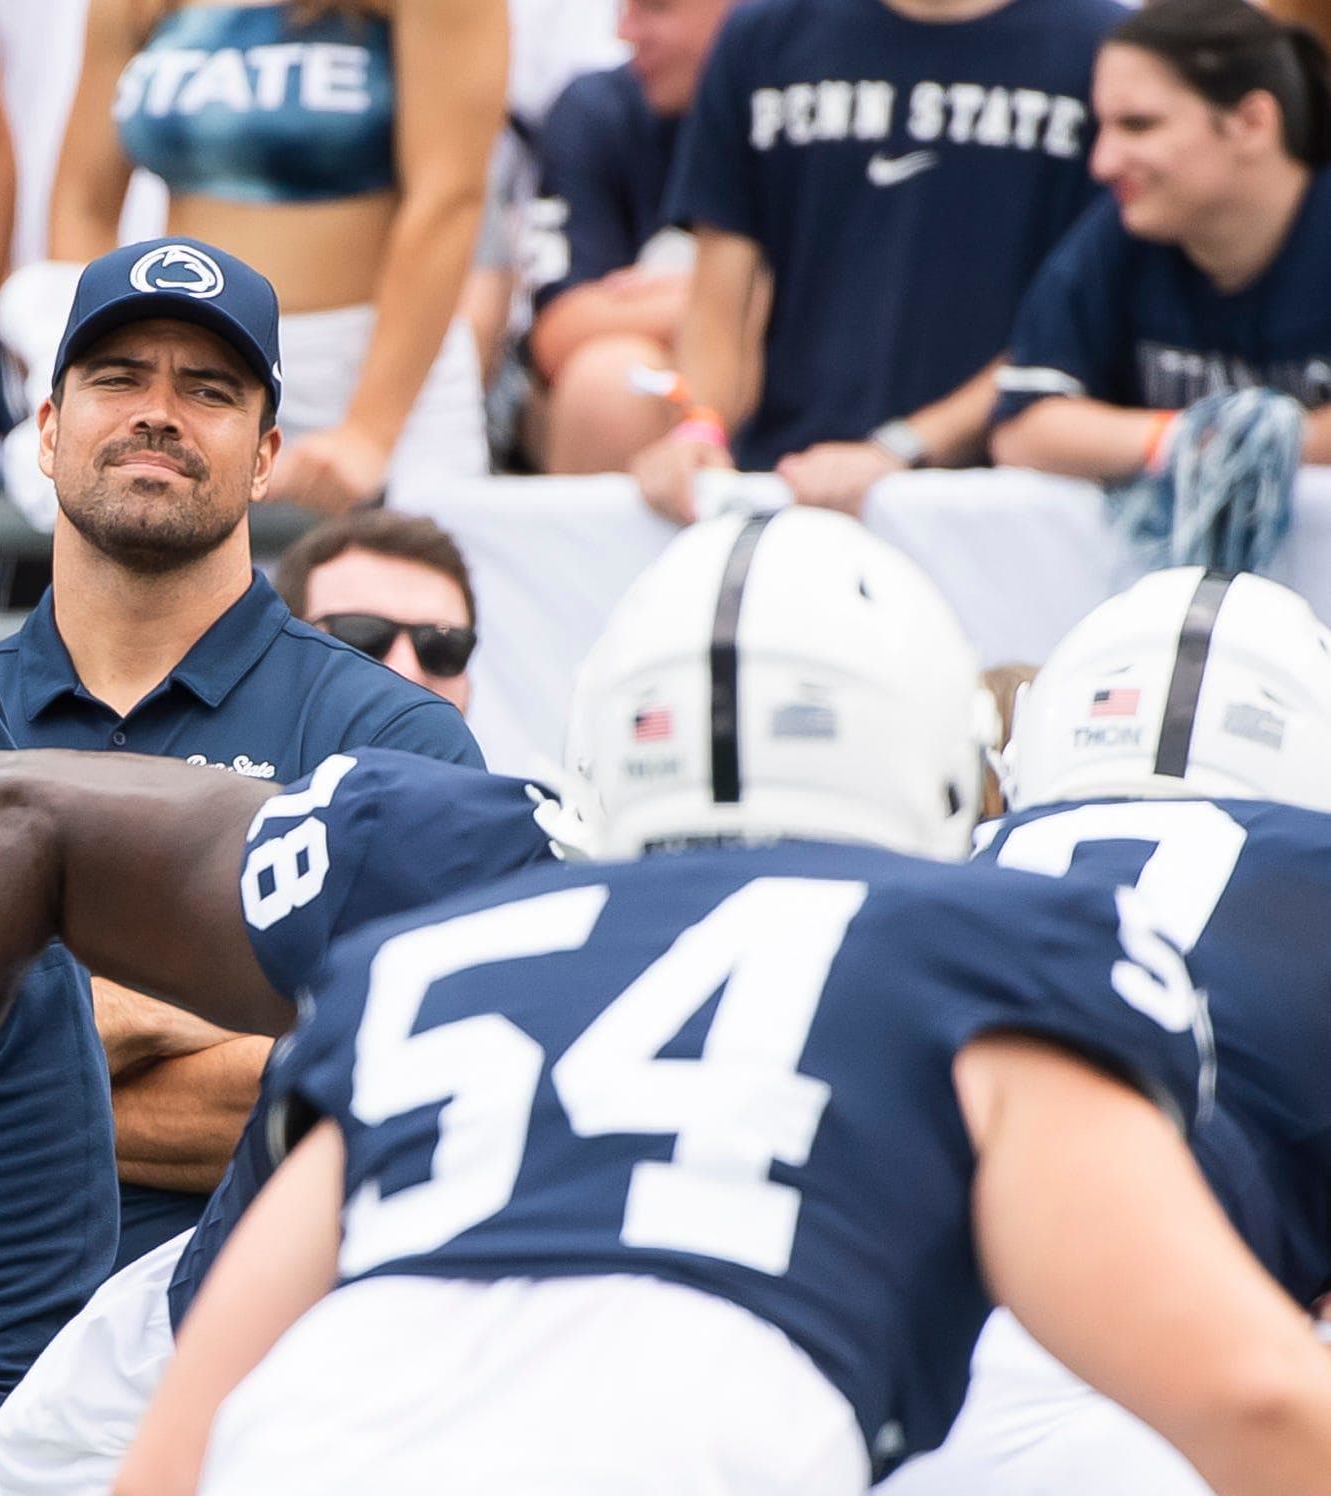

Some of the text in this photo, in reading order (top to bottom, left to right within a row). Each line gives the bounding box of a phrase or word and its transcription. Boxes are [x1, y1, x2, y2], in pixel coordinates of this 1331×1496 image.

[112, 42, 370, 120] STATE
[751, 79, 1086, 158] PENN STATE
[338, 875, 869, 1277] 54
